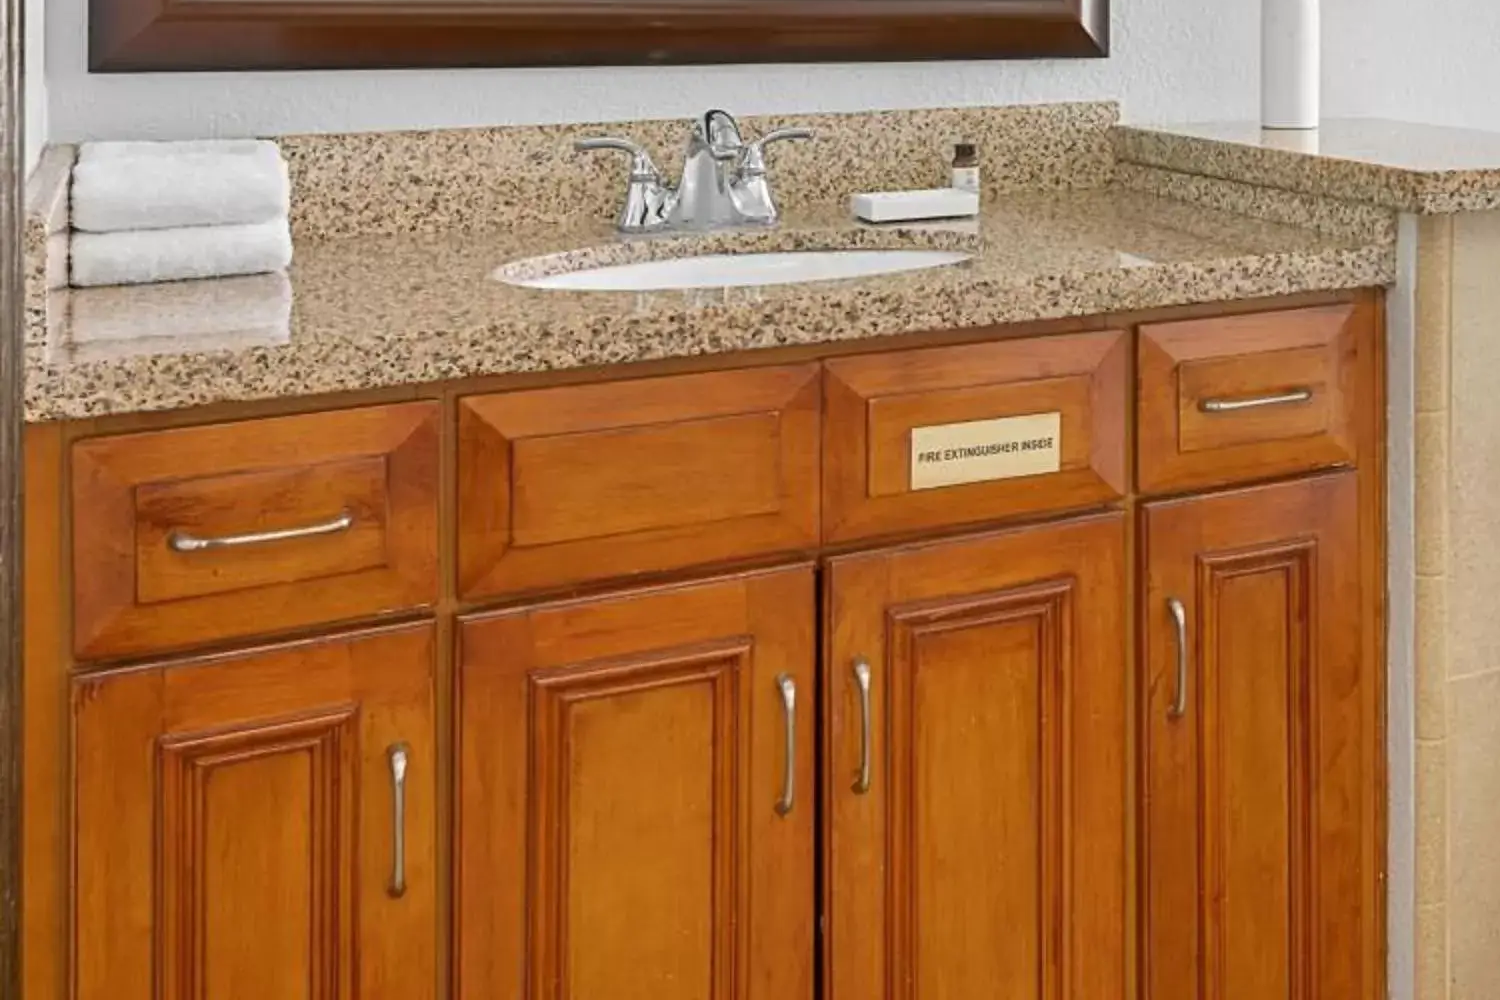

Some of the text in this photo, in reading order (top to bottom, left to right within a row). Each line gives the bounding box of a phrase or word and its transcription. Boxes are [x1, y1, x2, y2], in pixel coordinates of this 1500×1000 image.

[918, 437, 1053, 463] FIRE EXTINGUISHER INSIDE
